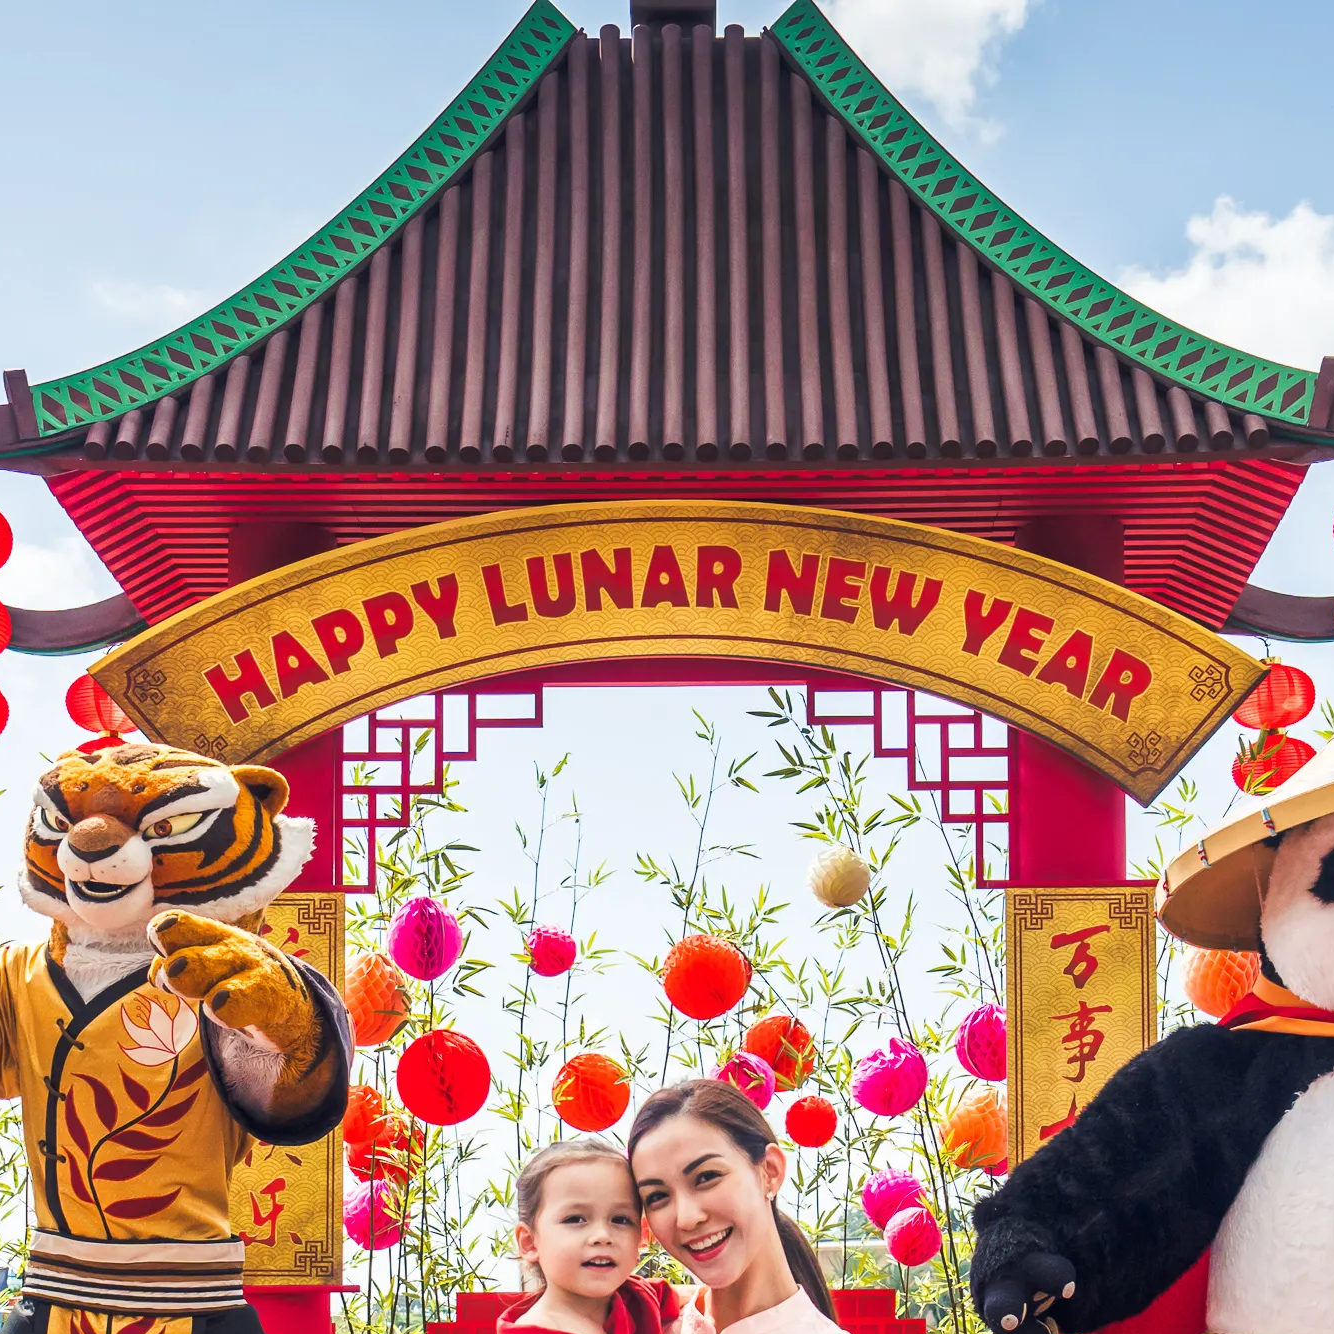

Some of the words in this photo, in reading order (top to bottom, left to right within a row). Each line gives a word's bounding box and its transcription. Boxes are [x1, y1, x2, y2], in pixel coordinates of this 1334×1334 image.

[202, 571, 460, 724] HAPPY
[481, 544, 743, 626] LUNAR
[763, 548, 944, 637] NEW
[961, 588, 1153, 723] YEAR
[1040, 924, 1113, 1141] 万事
